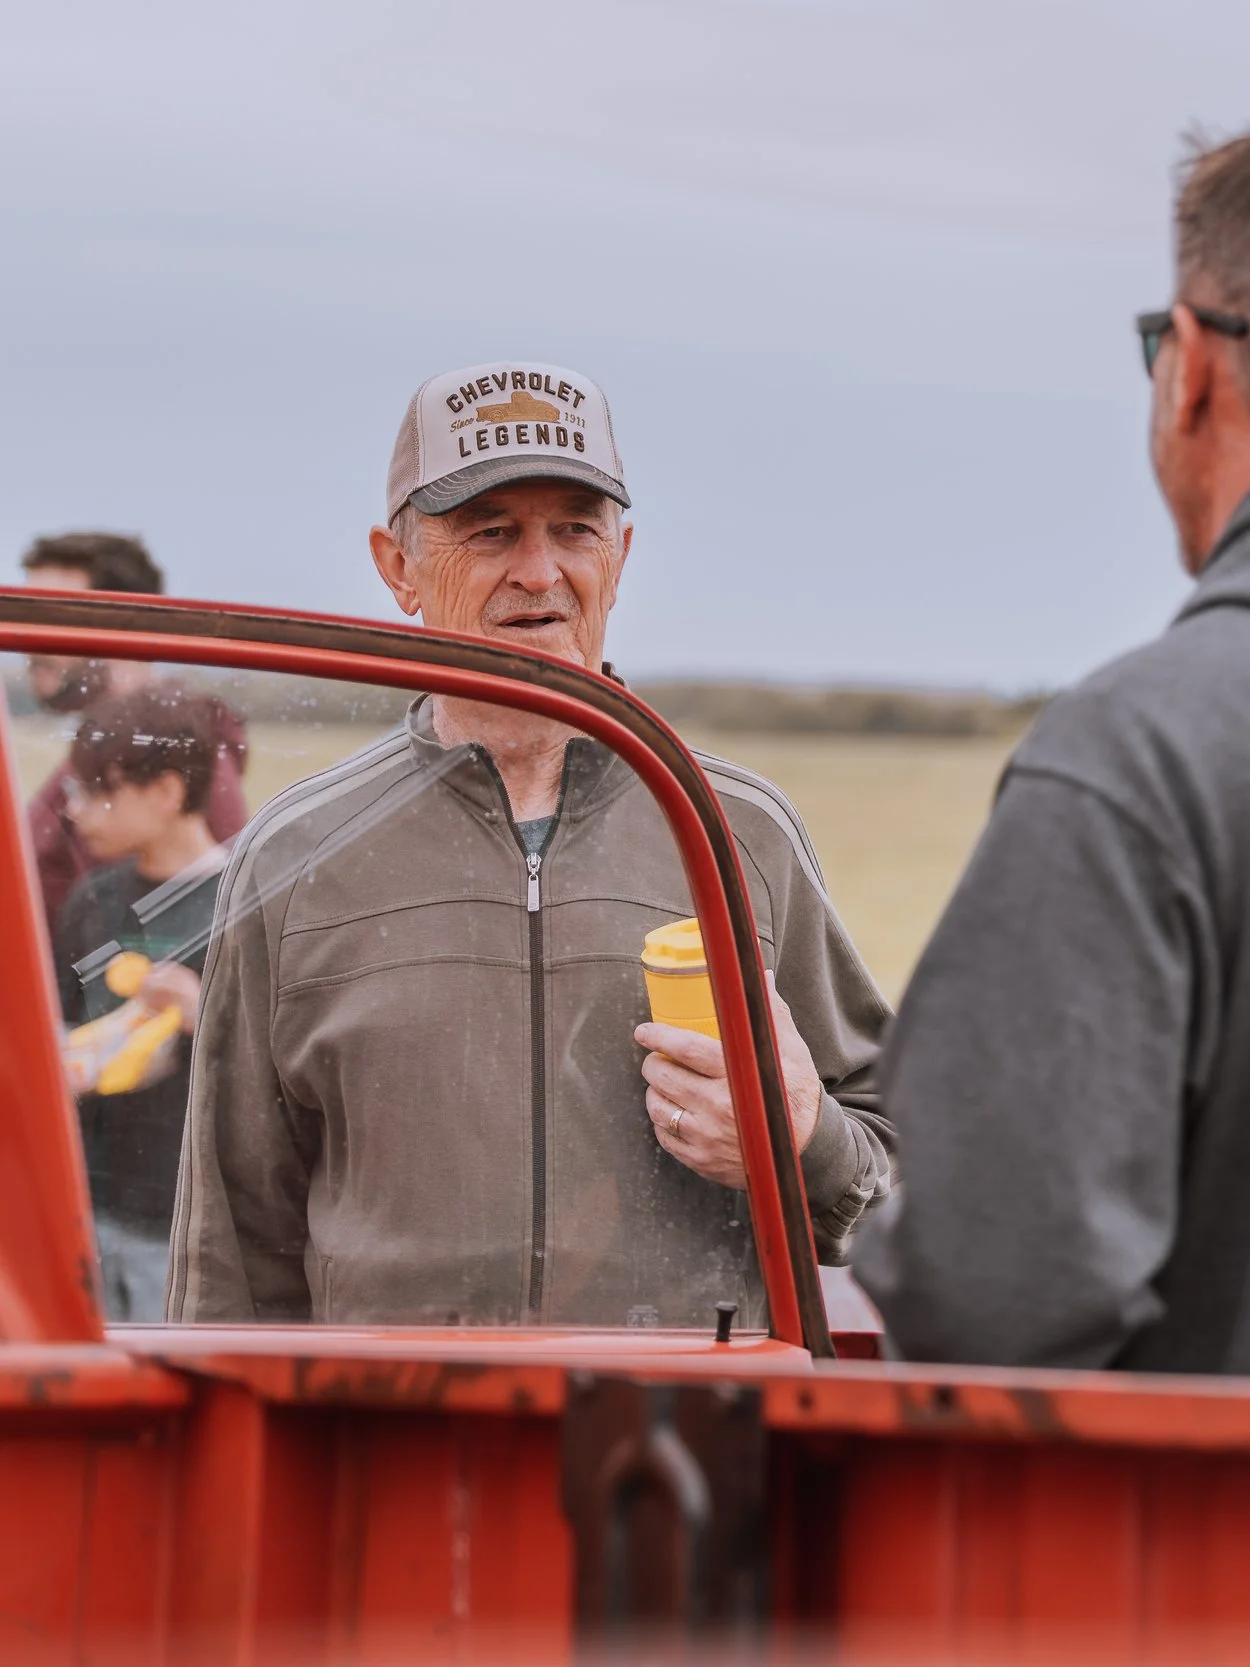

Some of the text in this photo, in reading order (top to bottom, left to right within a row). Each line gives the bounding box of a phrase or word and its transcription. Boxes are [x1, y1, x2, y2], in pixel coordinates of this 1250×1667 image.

[446, 371, 585, 413] CHEVROLET
[450, 412, 586, 432] Since 1911
[458, 423, 585, 458] LEGENDS
